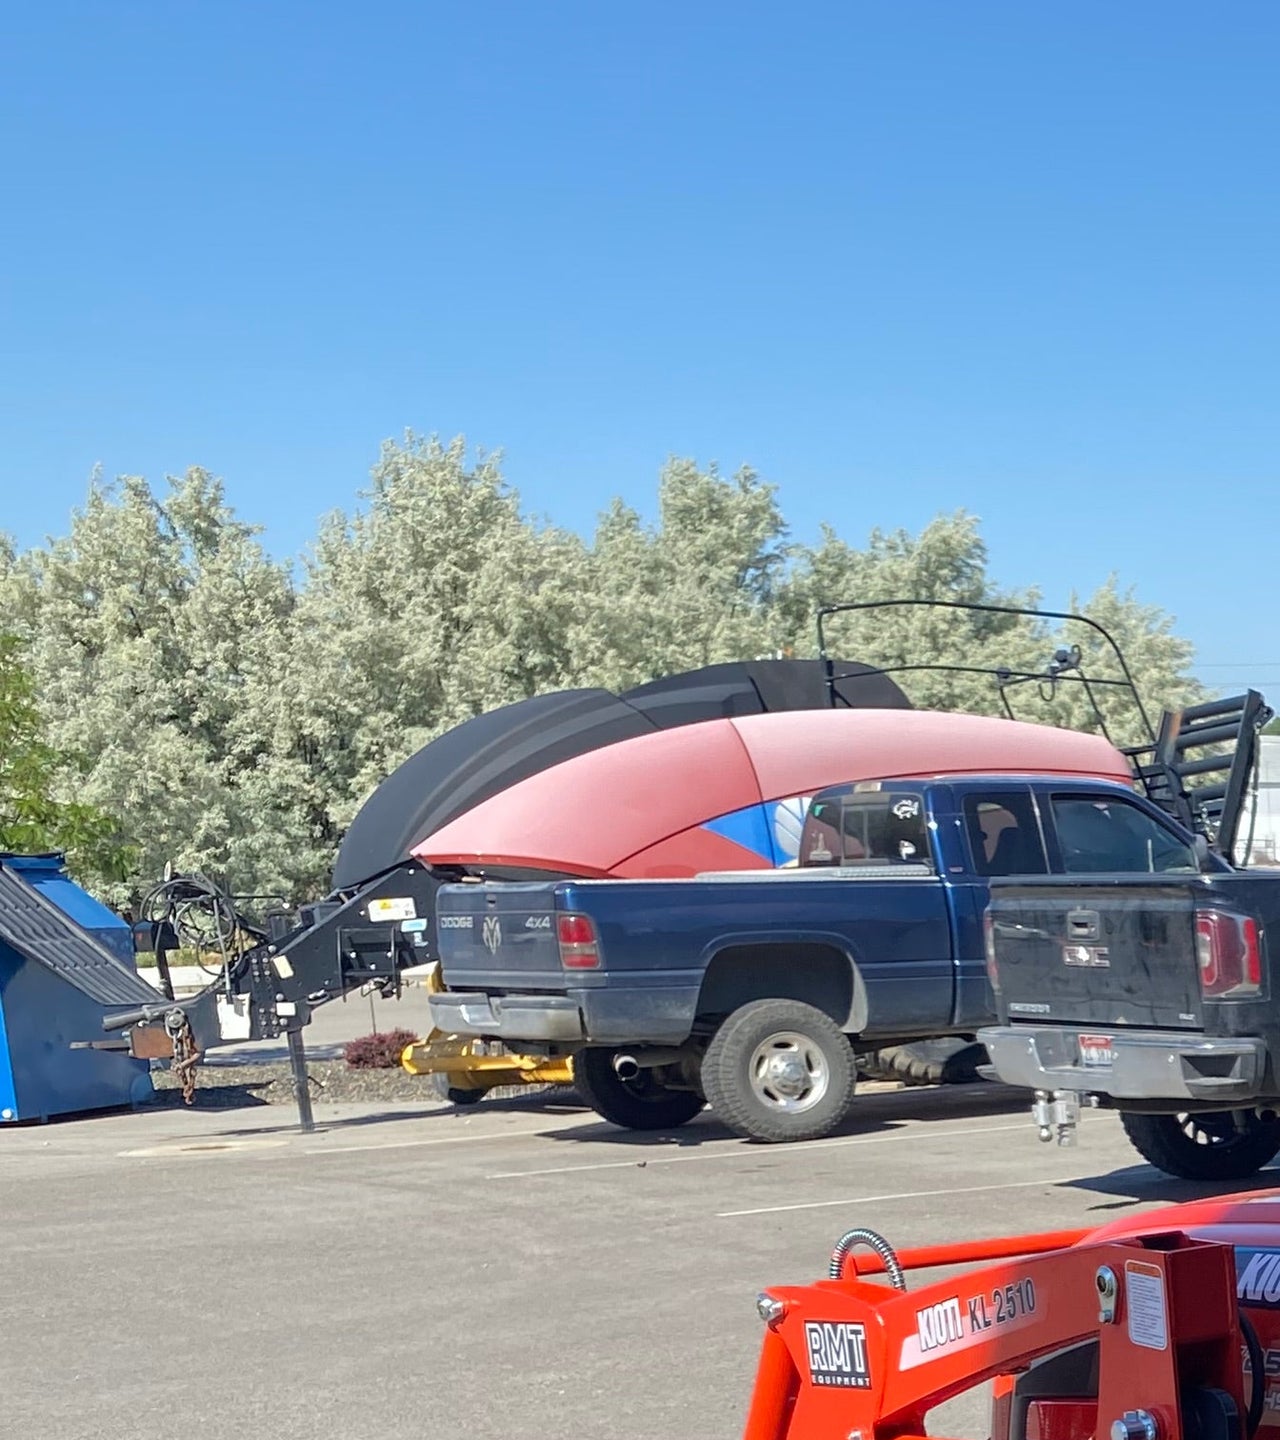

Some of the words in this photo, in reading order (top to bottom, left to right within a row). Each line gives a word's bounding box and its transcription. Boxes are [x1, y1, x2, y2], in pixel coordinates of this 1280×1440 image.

[440, 916, 474, 929] DODGE
[917, 1297, 963, 1352] KIOTI
[967, 1294, 993, 1334] KL
[992, 1277, 1036, 1326] 2510
[804, 1322, 866, 1373] RMT
[811, 1375, 870, 1386] EQUIPMENT
